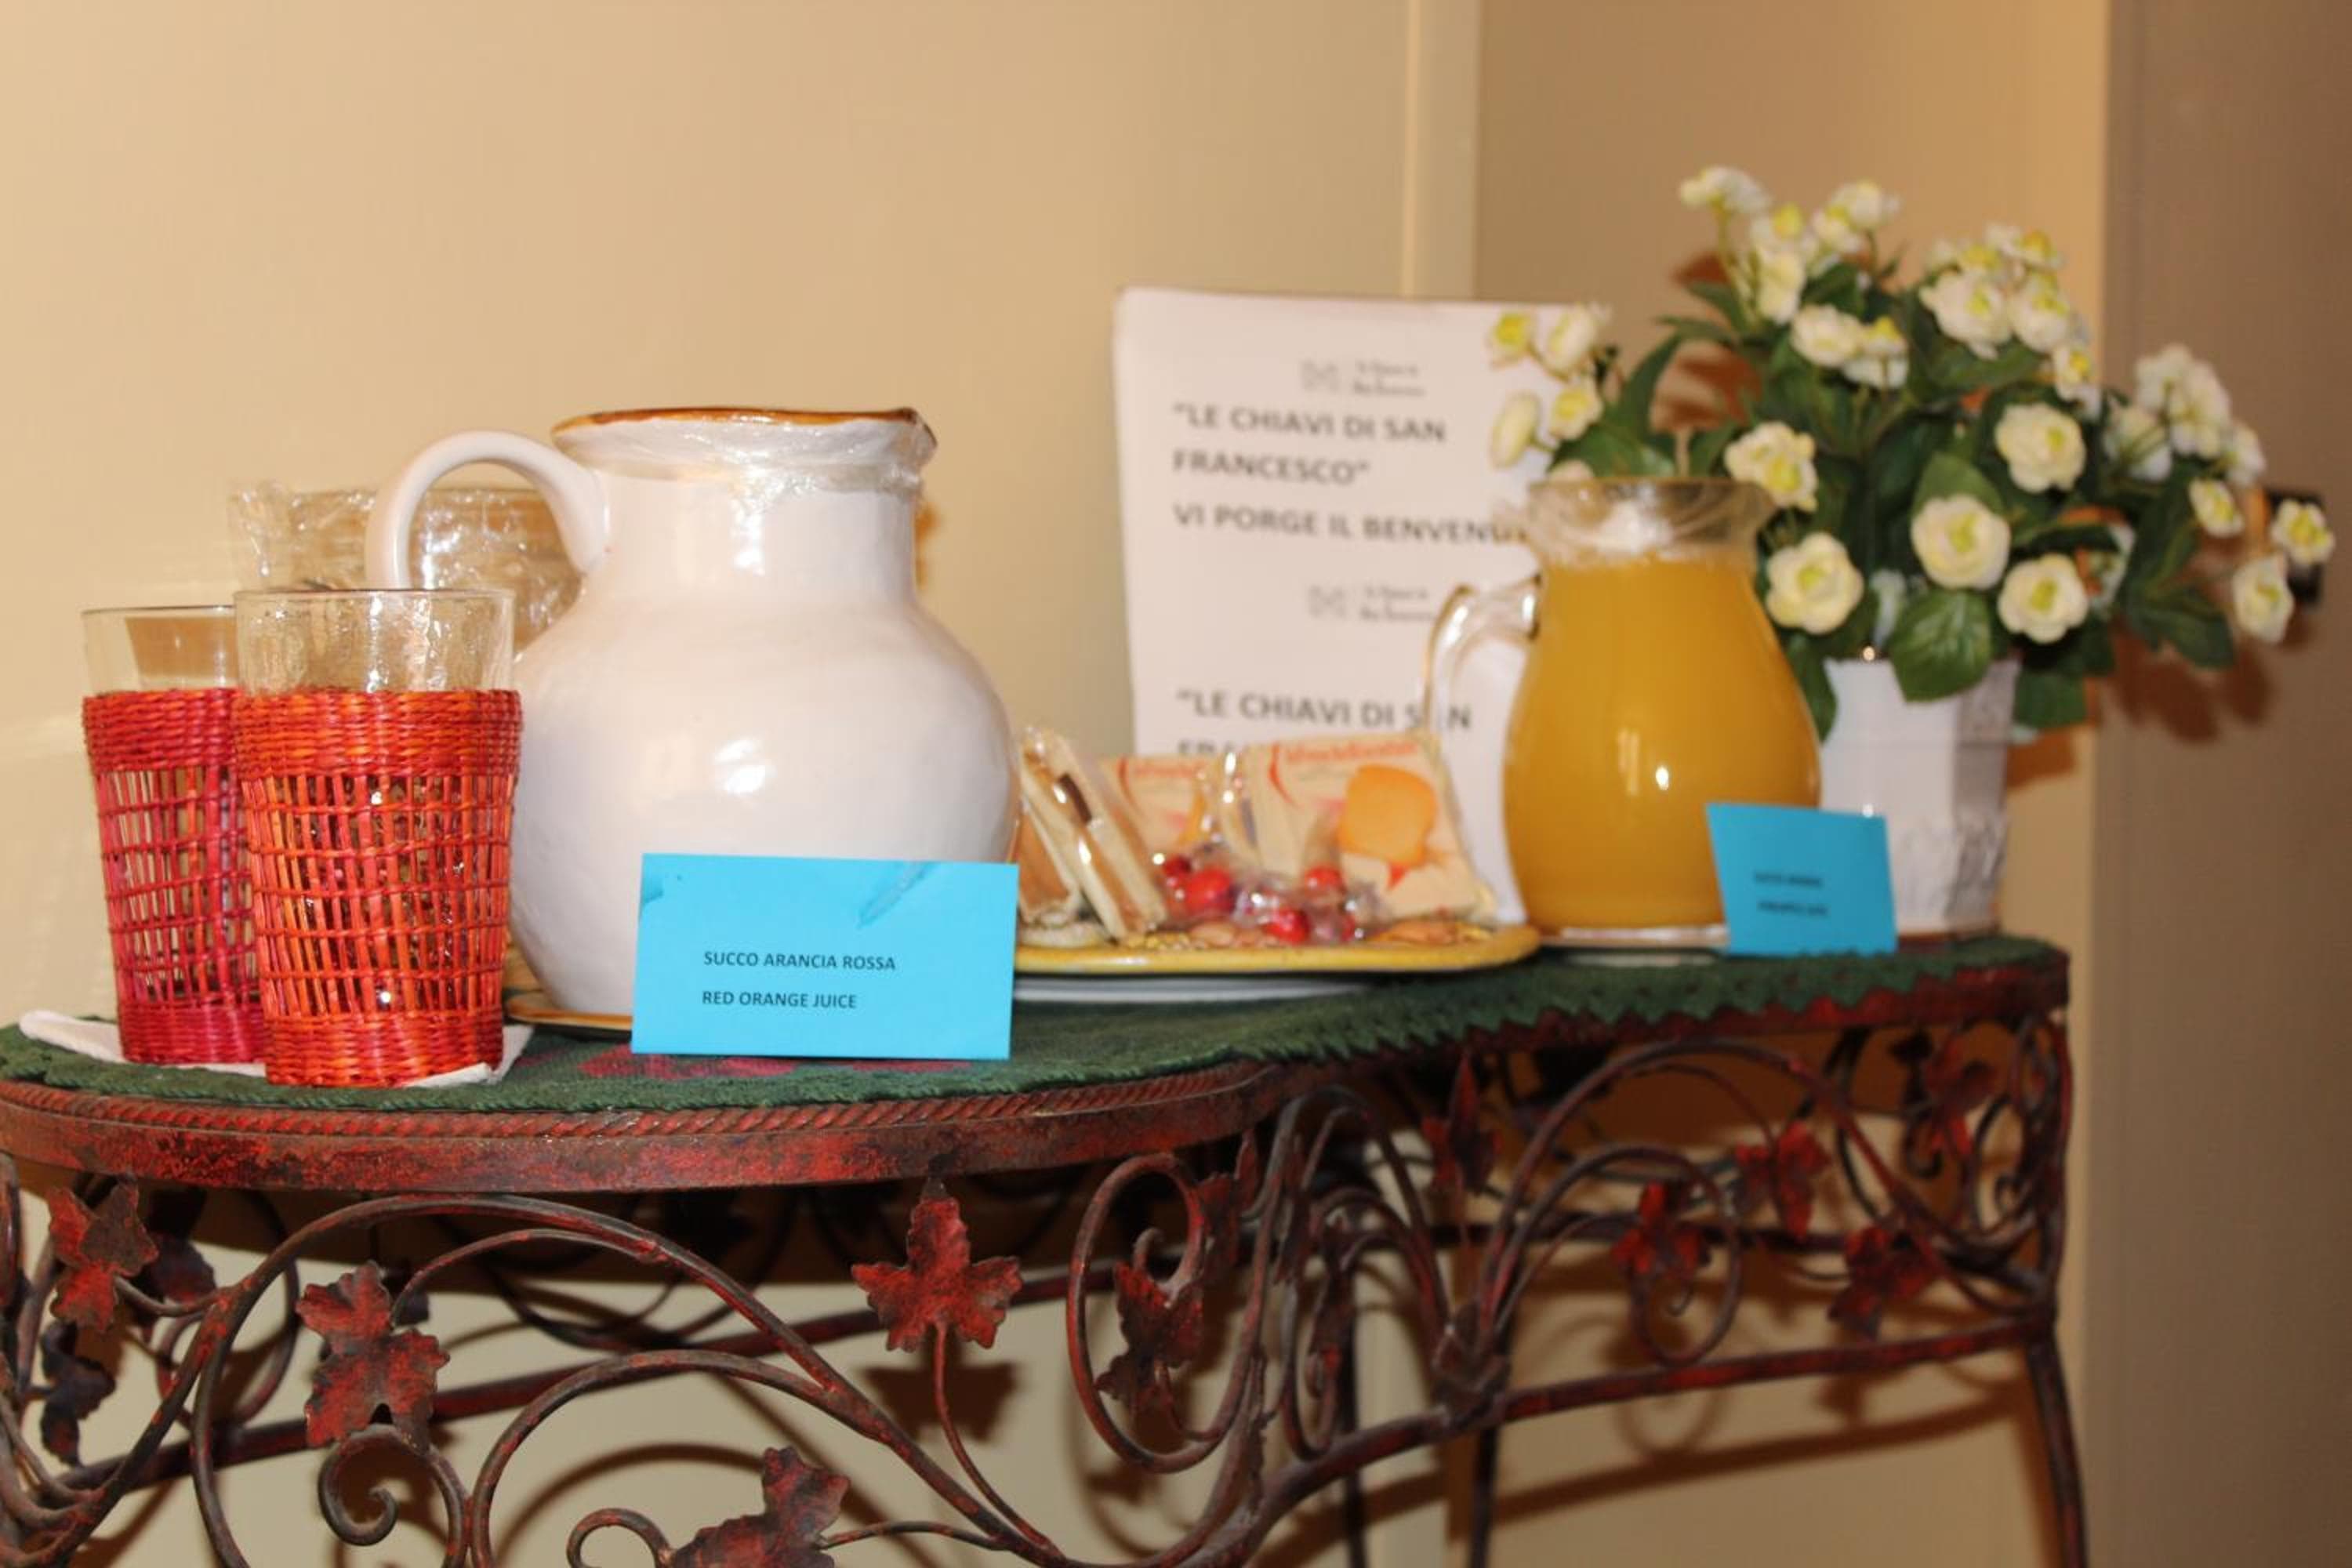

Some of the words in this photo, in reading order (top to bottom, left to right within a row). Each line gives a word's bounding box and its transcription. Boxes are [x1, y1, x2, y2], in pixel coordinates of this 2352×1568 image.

[1229, 407, 1335, 436] CHIAVI
[1341, 415, 1376, 440] DI
[1384, 418, 1446, 443] SAN
[1174, 504, 1205, 526] VI
[1214, 505, 1318, 535] PORGE
[1327, 514, 1352, 540] IL
[1238, 693, 1352, 726] CHIAVI
[1359, 701, 1396, 728] DI
[1404, 701, 1472, 731] SN
[703, 950, 760, 967] SUCCO
[763, 953, 838, 969] ARANCIA
[842, 955, 896, 971] ROSSA
[702, 990, 735, 1006] RED
[739, 991, 809, 1008] ORANGE
[812, 993, 857, 1009] JUICE
